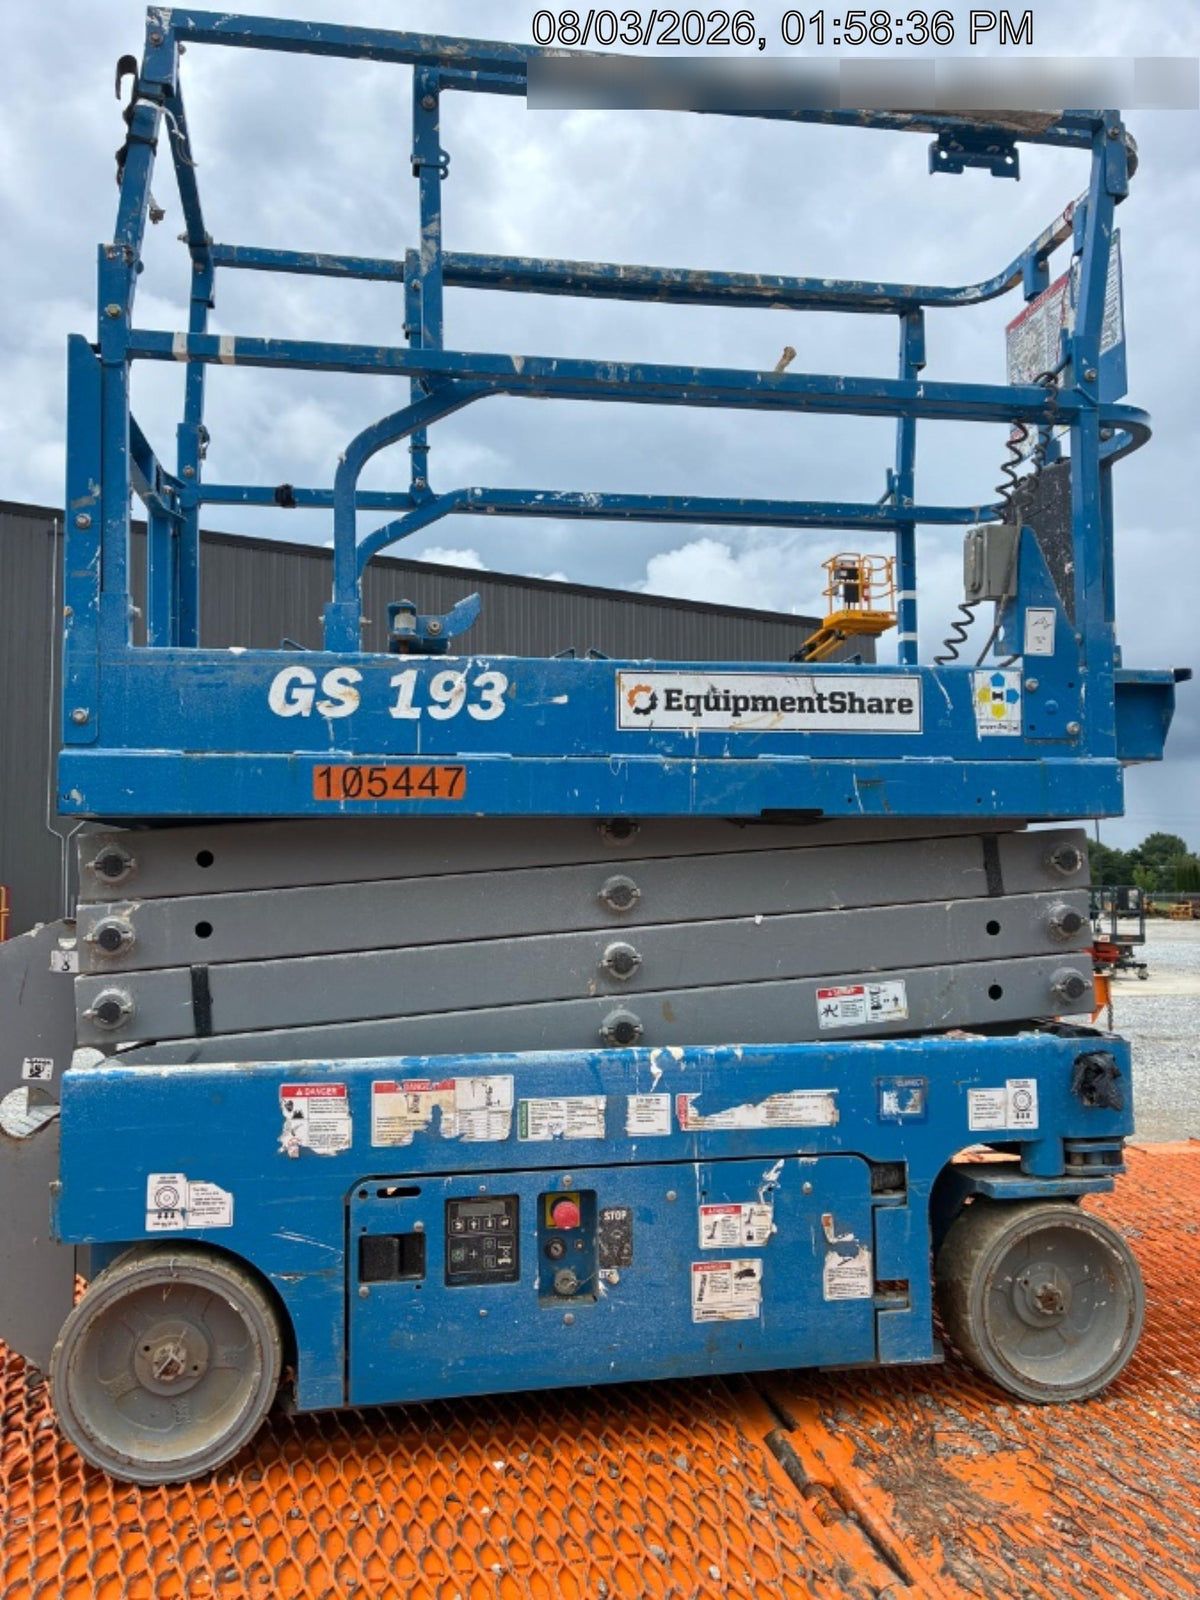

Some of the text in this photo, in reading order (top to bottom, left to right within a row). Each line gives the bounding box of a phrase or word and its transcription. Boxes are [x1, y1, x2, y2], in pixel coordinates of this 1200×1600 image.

[267, 665, 508, 722] GS 193
[664, 687, 913, 717] EquipmentShare
[317, 766, 464, 798] 105447
[603, 1209, 627, 1221] STOP
